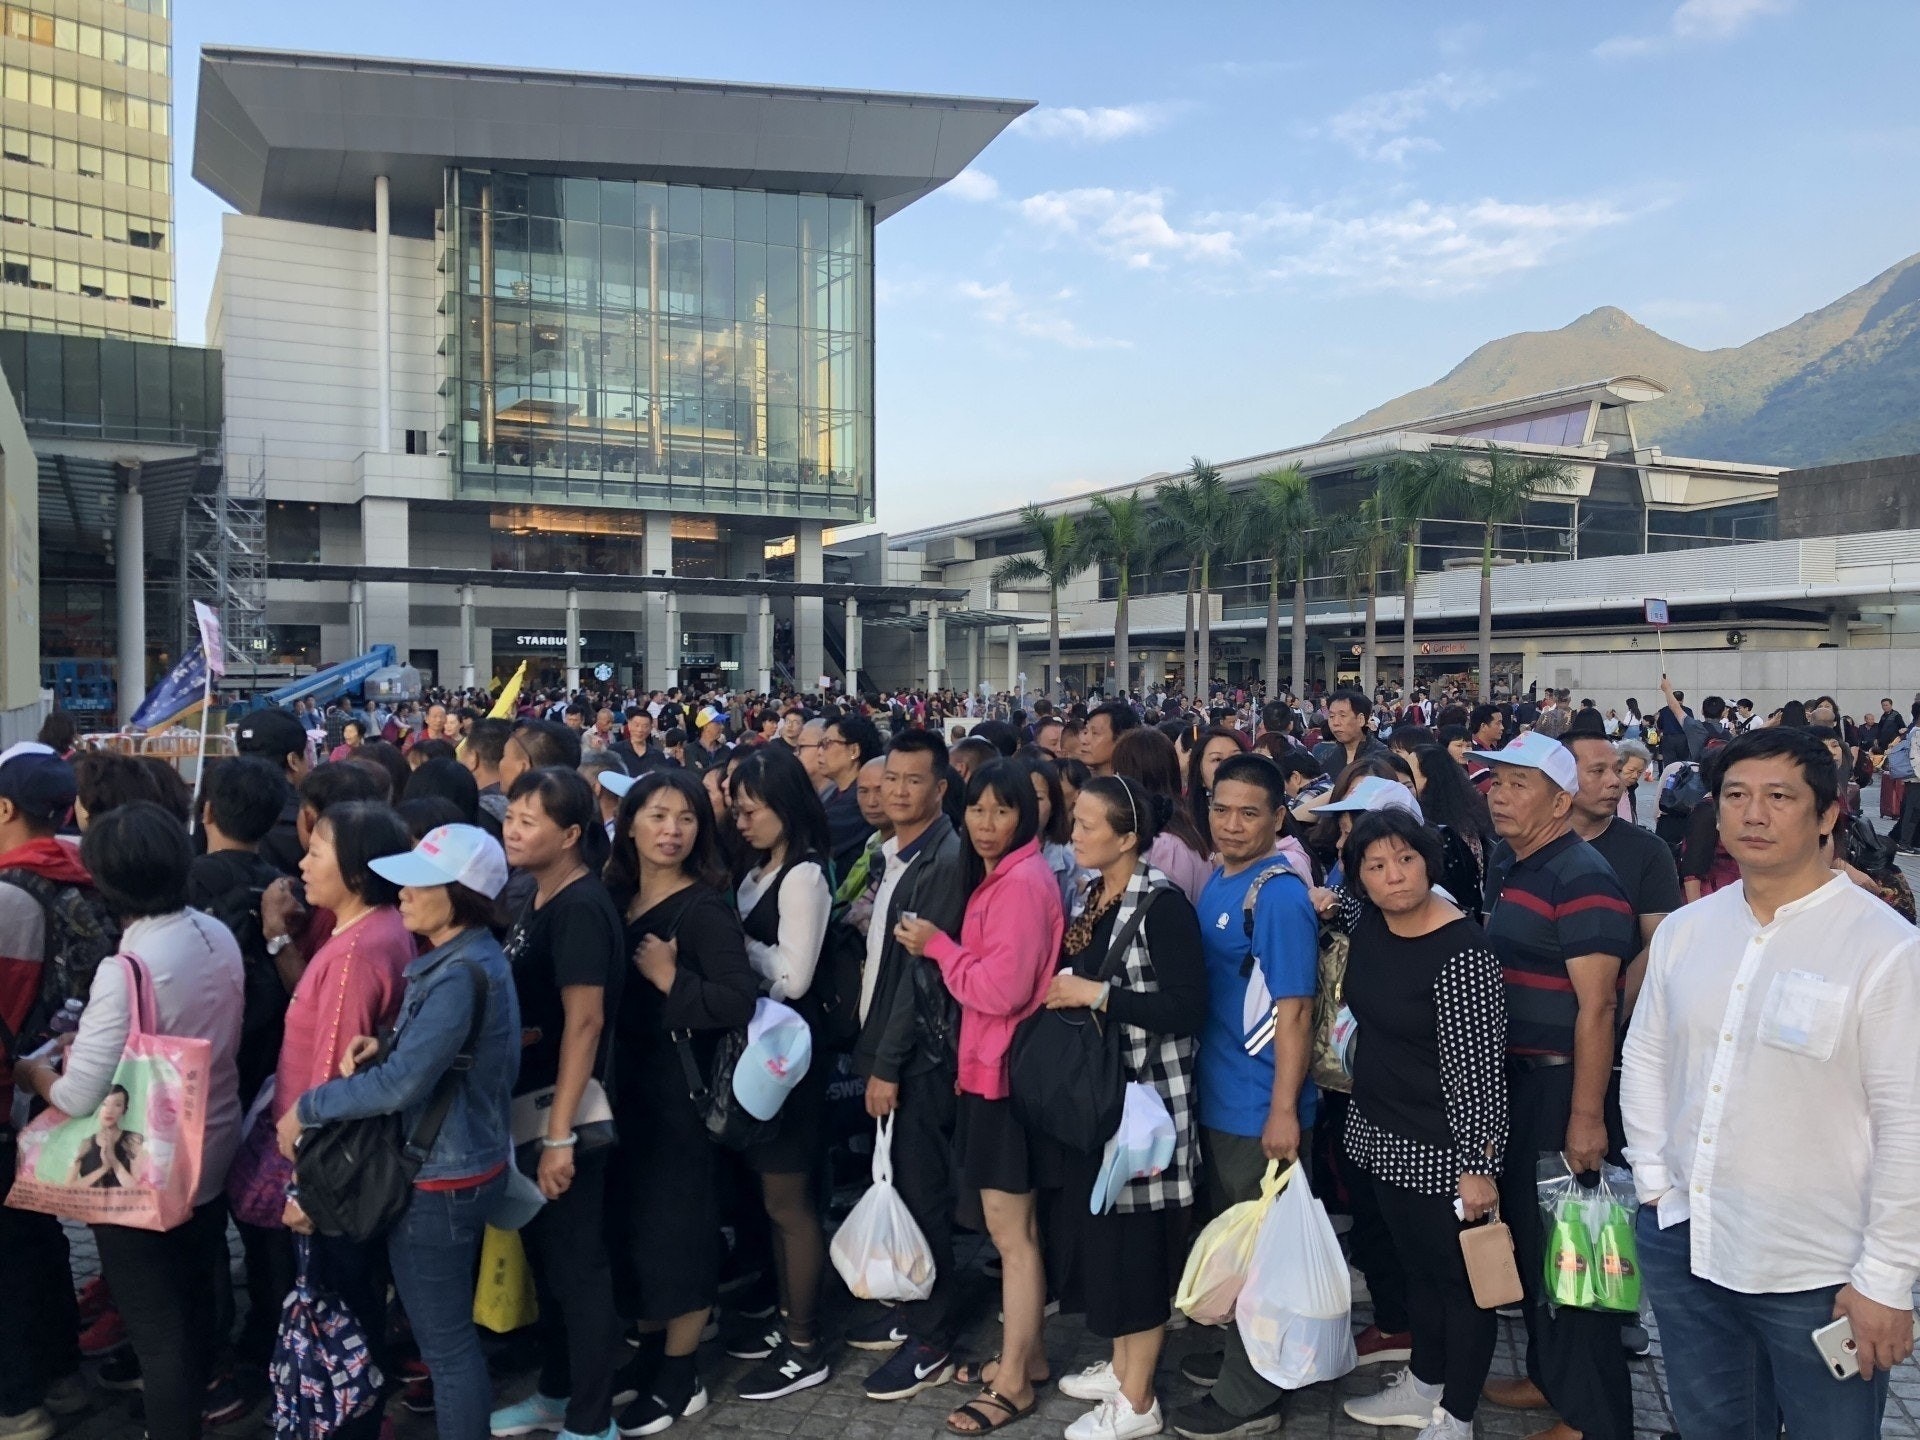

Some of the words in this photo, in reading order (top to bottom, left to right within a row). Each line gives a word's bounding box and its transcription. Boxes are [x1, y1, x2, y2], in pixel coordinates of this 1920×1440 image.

[517, 635, 587, 646] STARBUS
[1433, 643, 1457, 653] Circle
[1459, 642, 1466, 652] K
[779, 1359, 803, 1380] N
